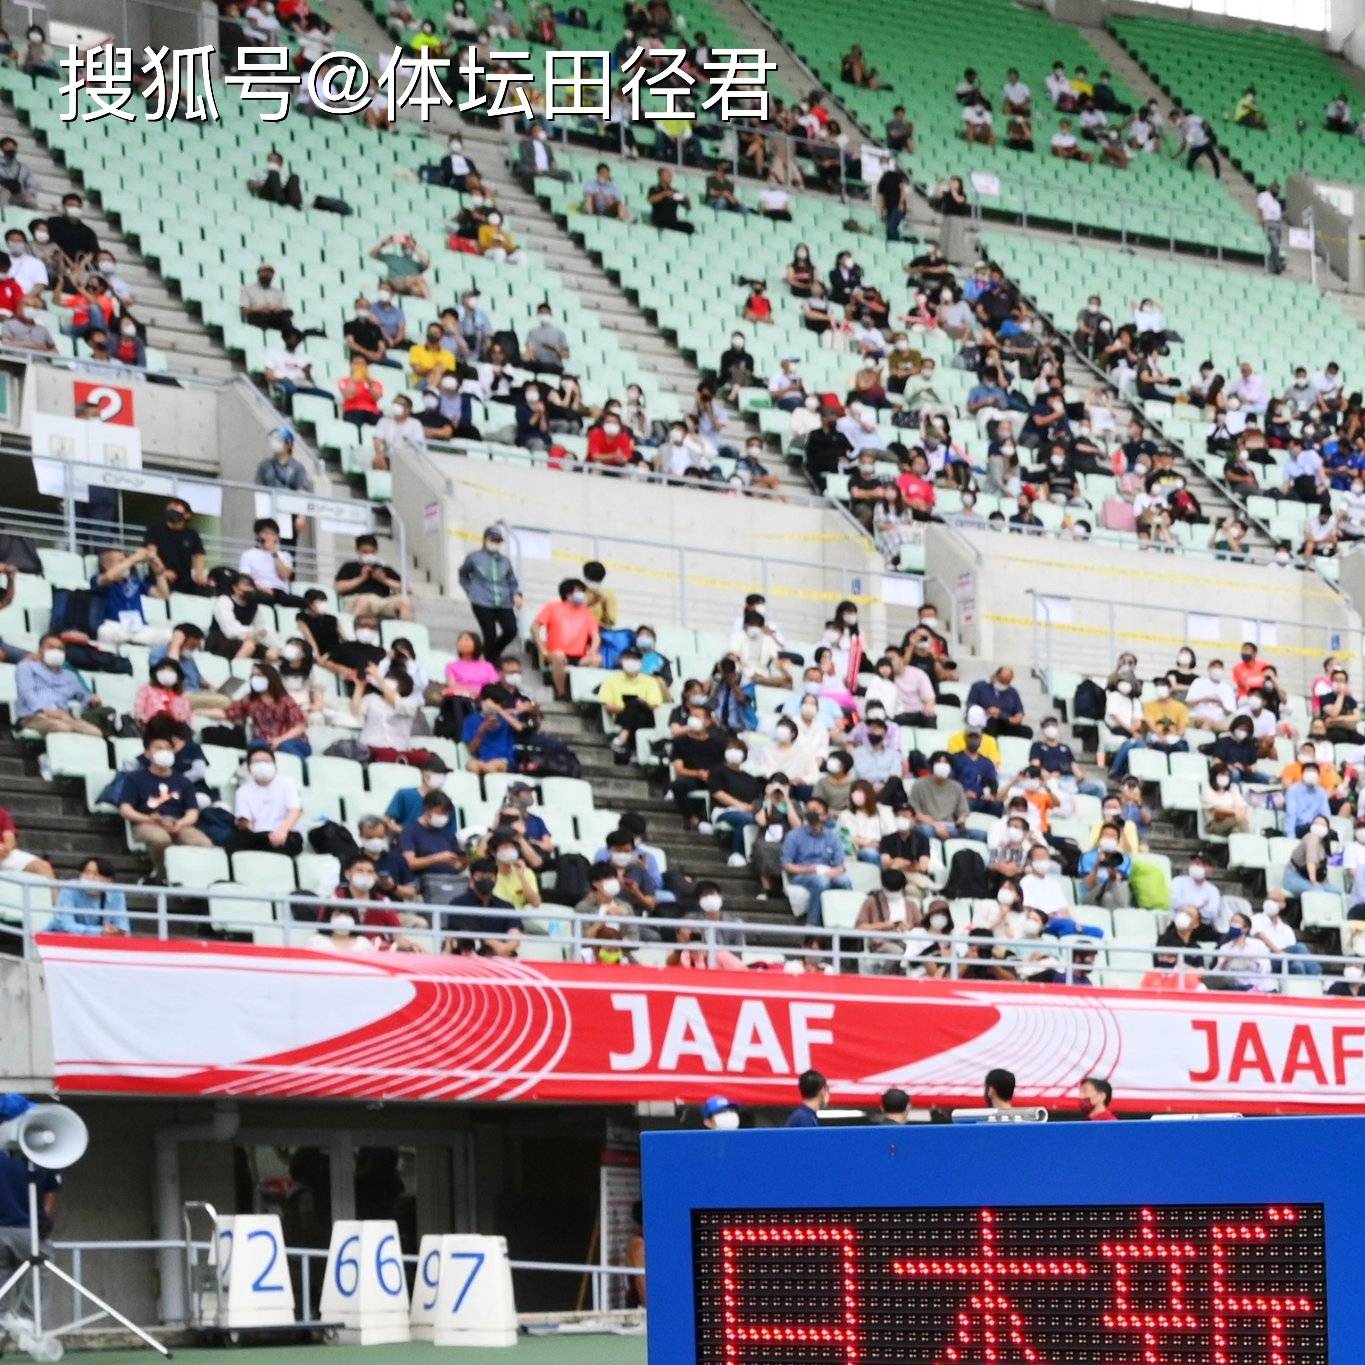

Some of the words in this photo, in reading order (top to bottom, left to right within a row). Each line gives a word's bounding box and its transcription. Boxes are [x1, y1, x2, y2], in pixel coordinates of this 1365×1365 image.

[609, 992, 836, 1074] JAAF
[247, 1230, 284, 1292] 2
[450, 1252, 485, 1314] 7
